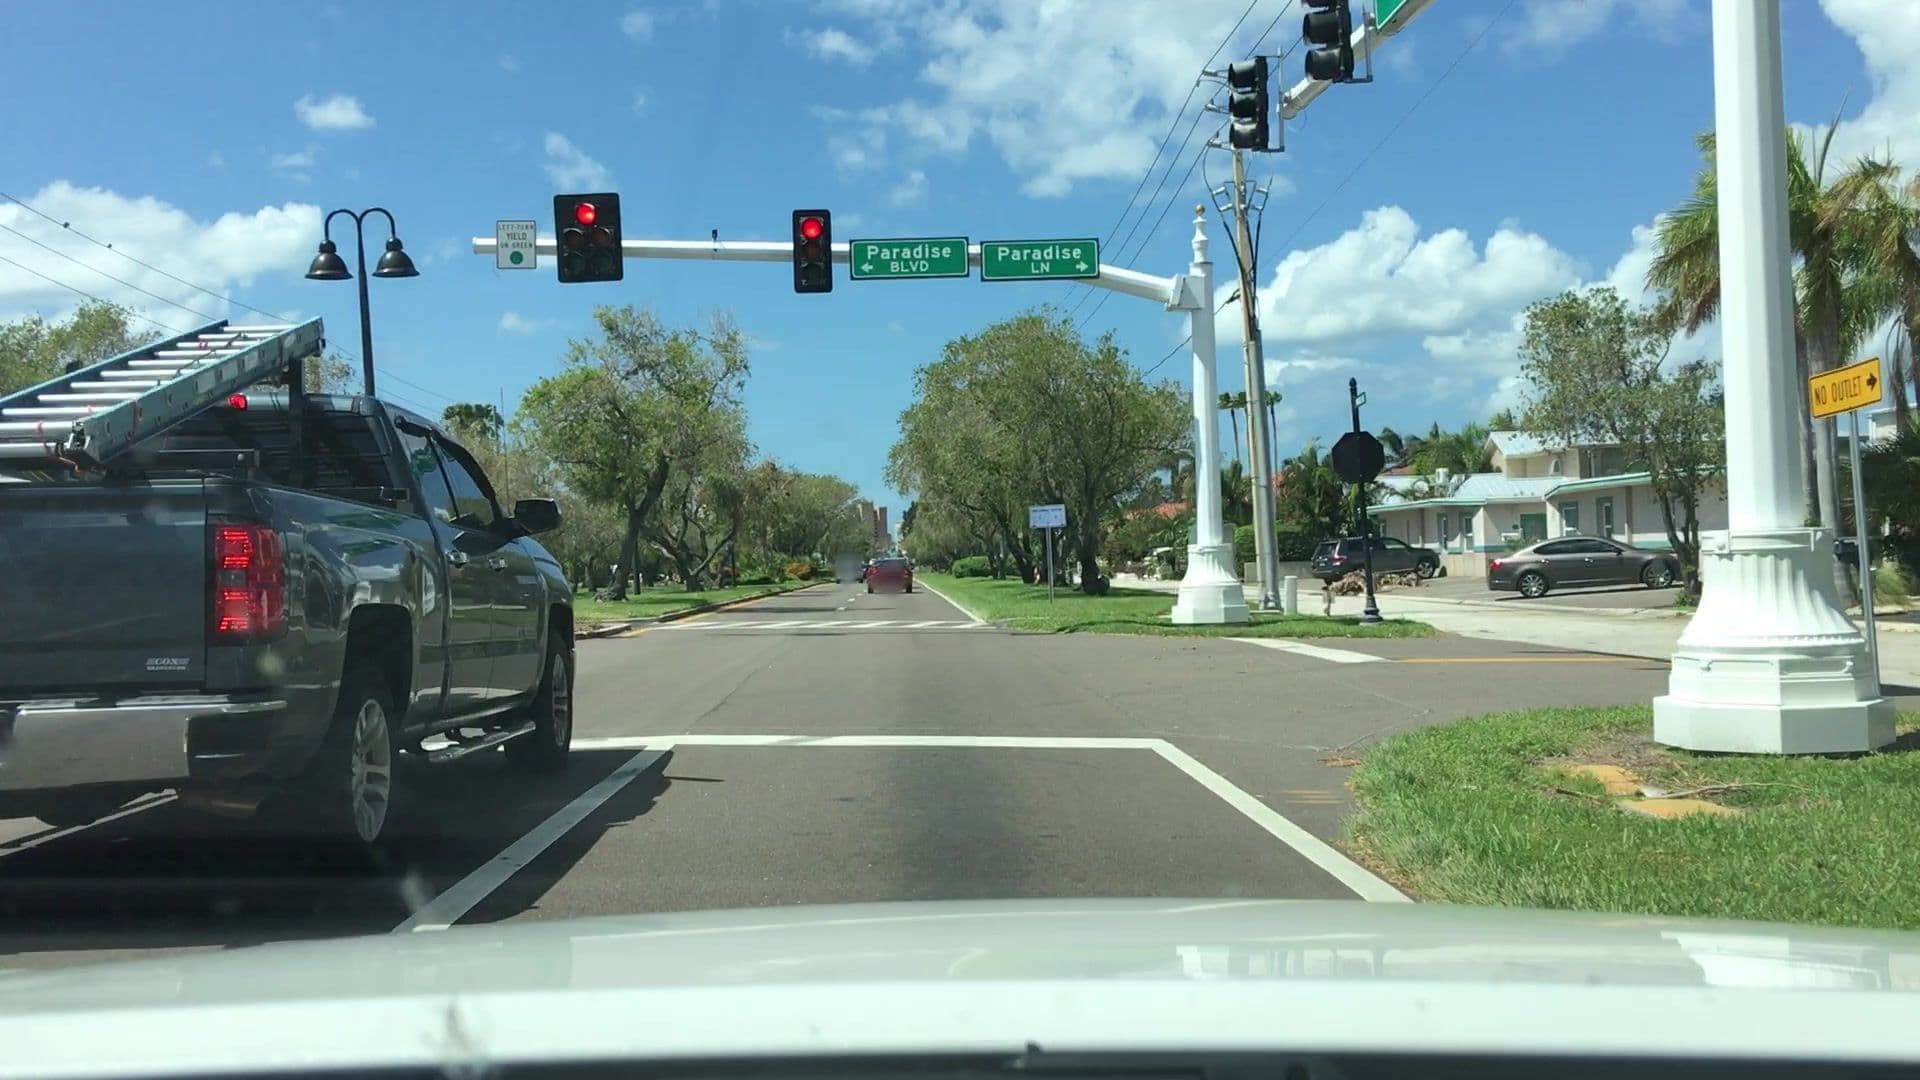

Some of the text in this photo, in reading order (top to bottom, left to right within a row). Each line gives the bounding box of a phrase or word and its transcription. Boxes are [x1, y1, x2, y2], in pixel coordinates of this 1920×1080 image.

[506, 232, 528, 240] YIELD
[866, 244, 952, 260] Paradise
[997, 245, 1082, 261] Paradise
[890, 260, 929, 273] BLVD
[1031, 261, 1050, 274] LN
[1814, 375, 1861, 406] NO OUTLET
